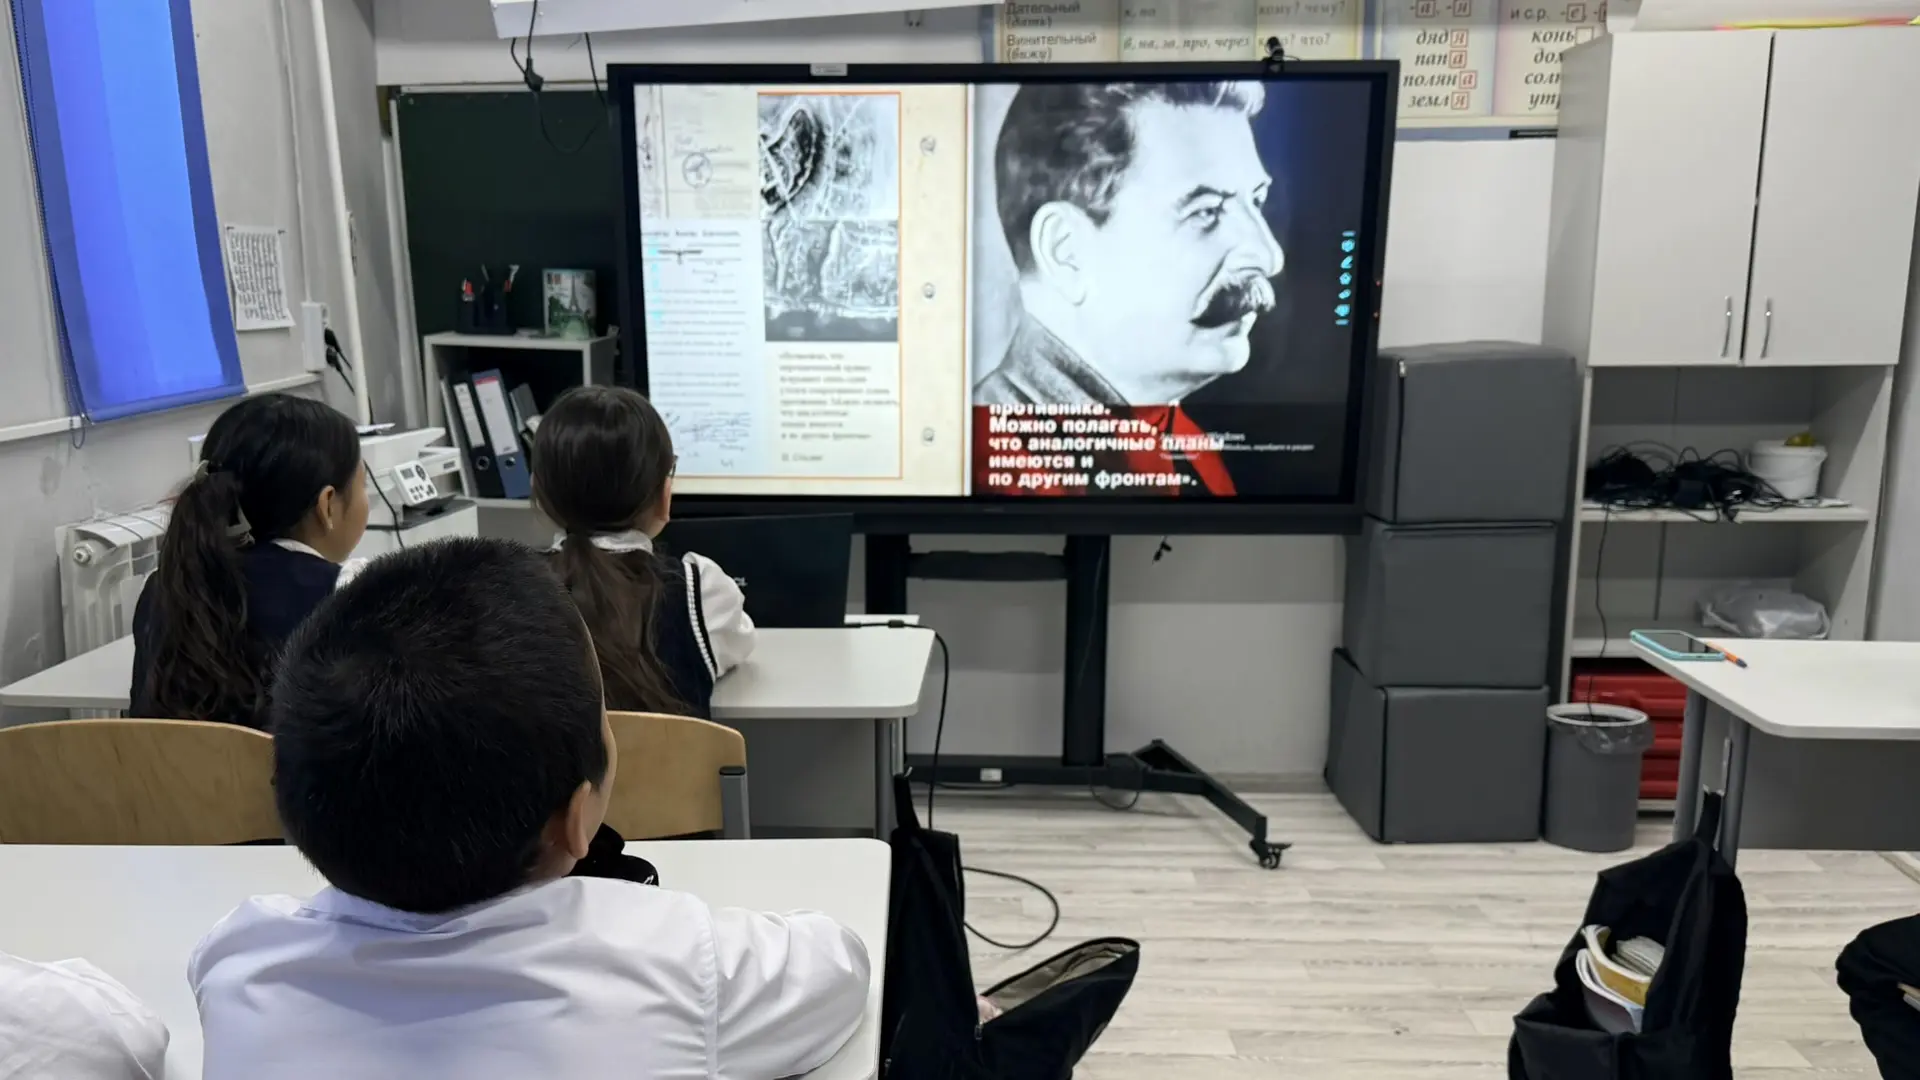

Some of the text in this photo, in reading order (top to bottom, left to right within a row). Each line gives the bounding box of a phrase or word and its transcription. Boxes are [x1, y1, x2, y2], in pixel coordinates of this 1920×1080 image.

[1006, 32, 1098, 47] Винительный
[1214, 37, 1250, 51] через
[1300, 33, 1330, 47] что?
[1531, 28, 1575, 44] конь
[1414, 51, 1466, 67] папа
[1402, 71, 1475, 88] поляна
[1407, 93, 1468, 108] земля
[988, 403, 1112, 419] противника.
[988, 416, 1158, 435] Можно полагать,
[988, 436, 1023, 451] что
[1028, 436, 1156, 451] аналогичные
[1161, 436, 1225, 452] планы
[988, 455, 1094, 468] имеются и
[988, 470, 1198, 489] по другим фронтам».
